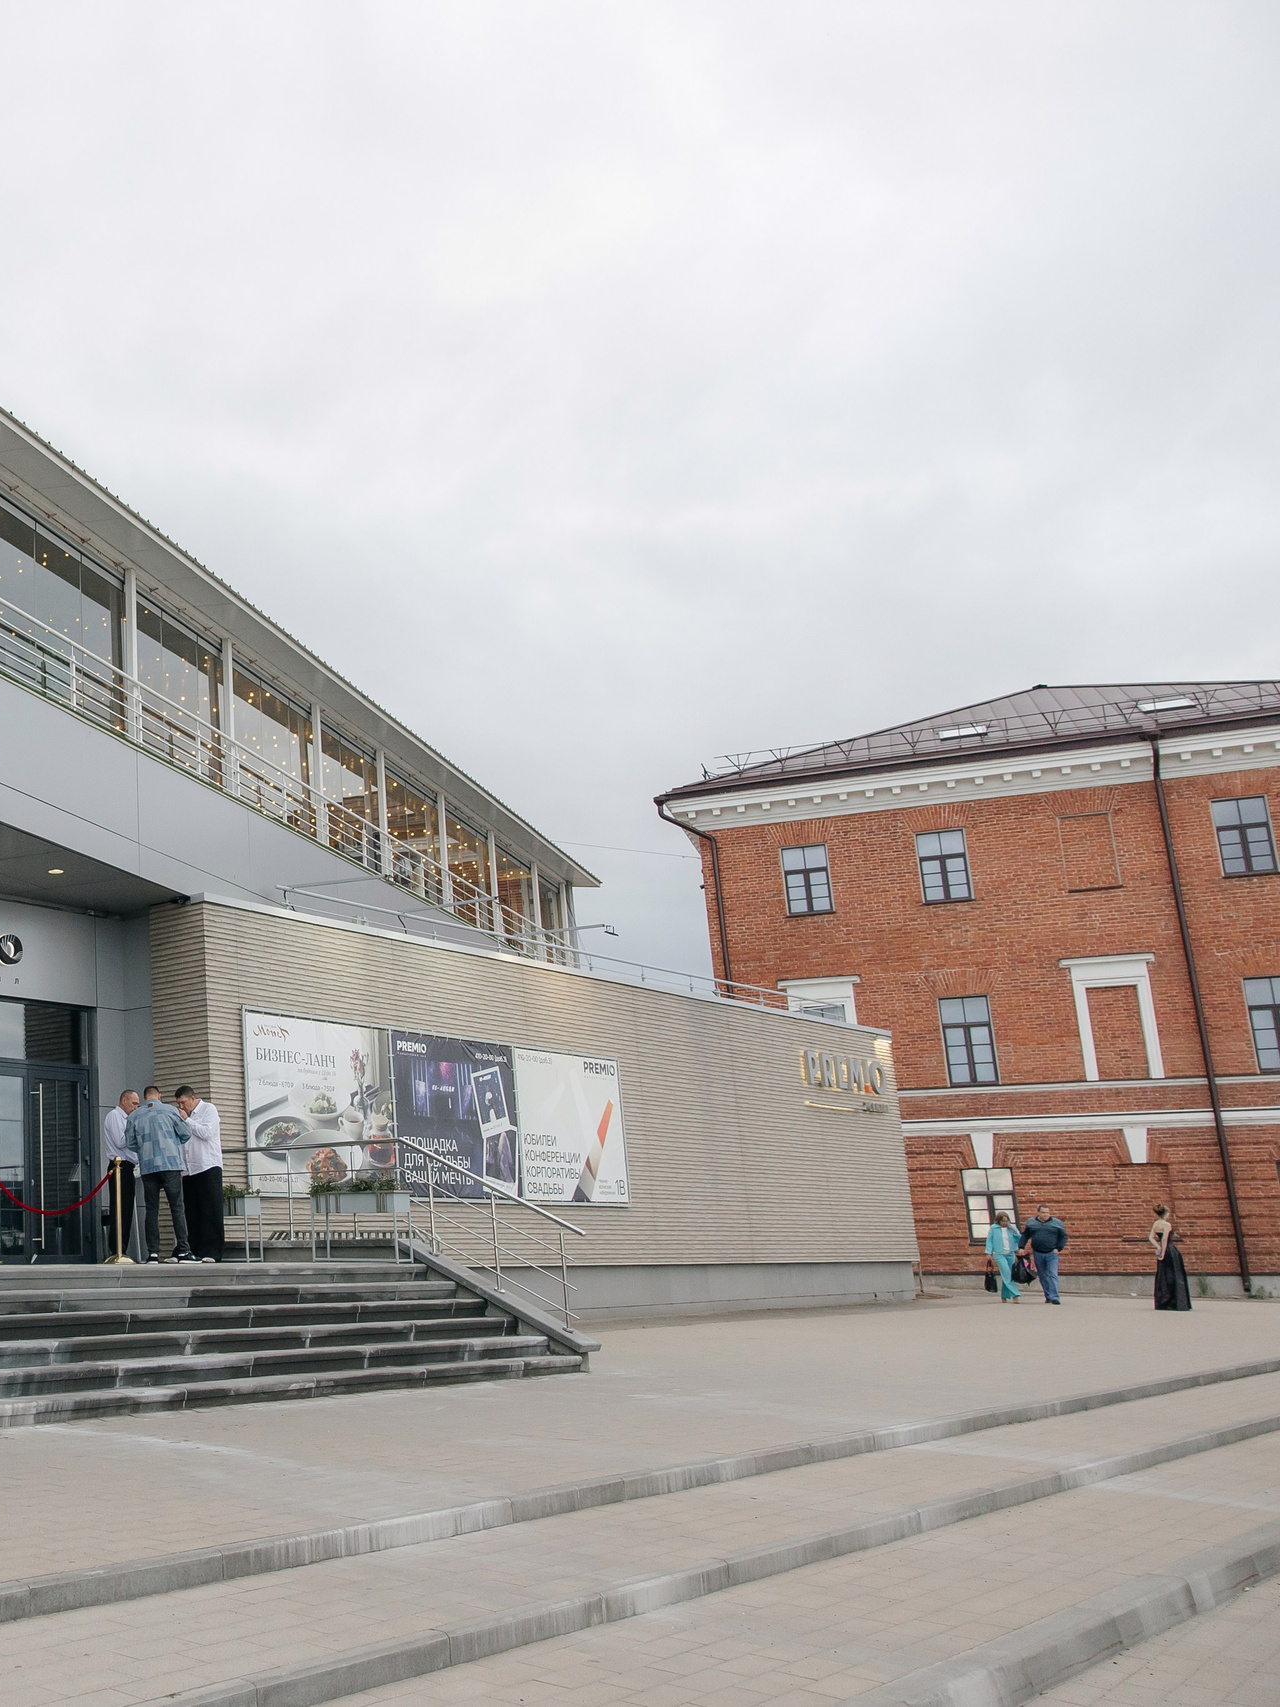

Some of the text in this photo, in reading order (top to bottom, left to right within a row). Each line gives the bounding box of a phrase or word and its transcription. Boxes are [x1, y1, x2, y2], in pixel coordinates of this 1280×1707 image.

[396, 1040, 427, 1053] PREMIO
[255, 1047, 336, 1068] БИЗНЕС-ЛАНЧ
[583, 1061, 615, 1076] PREMIO
[803, 1049, 887, 1095] PREMIO
[523, 1133, 557, 1146] ЮБИЛЕИ
[404, 1153, 424, 1169] ДЛЯ
[524, 1149, 581, 1165] КОНФЕРЕНЦИИ
[405, 1168, 440, 1184] ВАШЙ
[526, 1165, 582, 1180] КОРПОРАТИВЫ
[527, 1181, 565, 1197] СВАДЬБЫ
